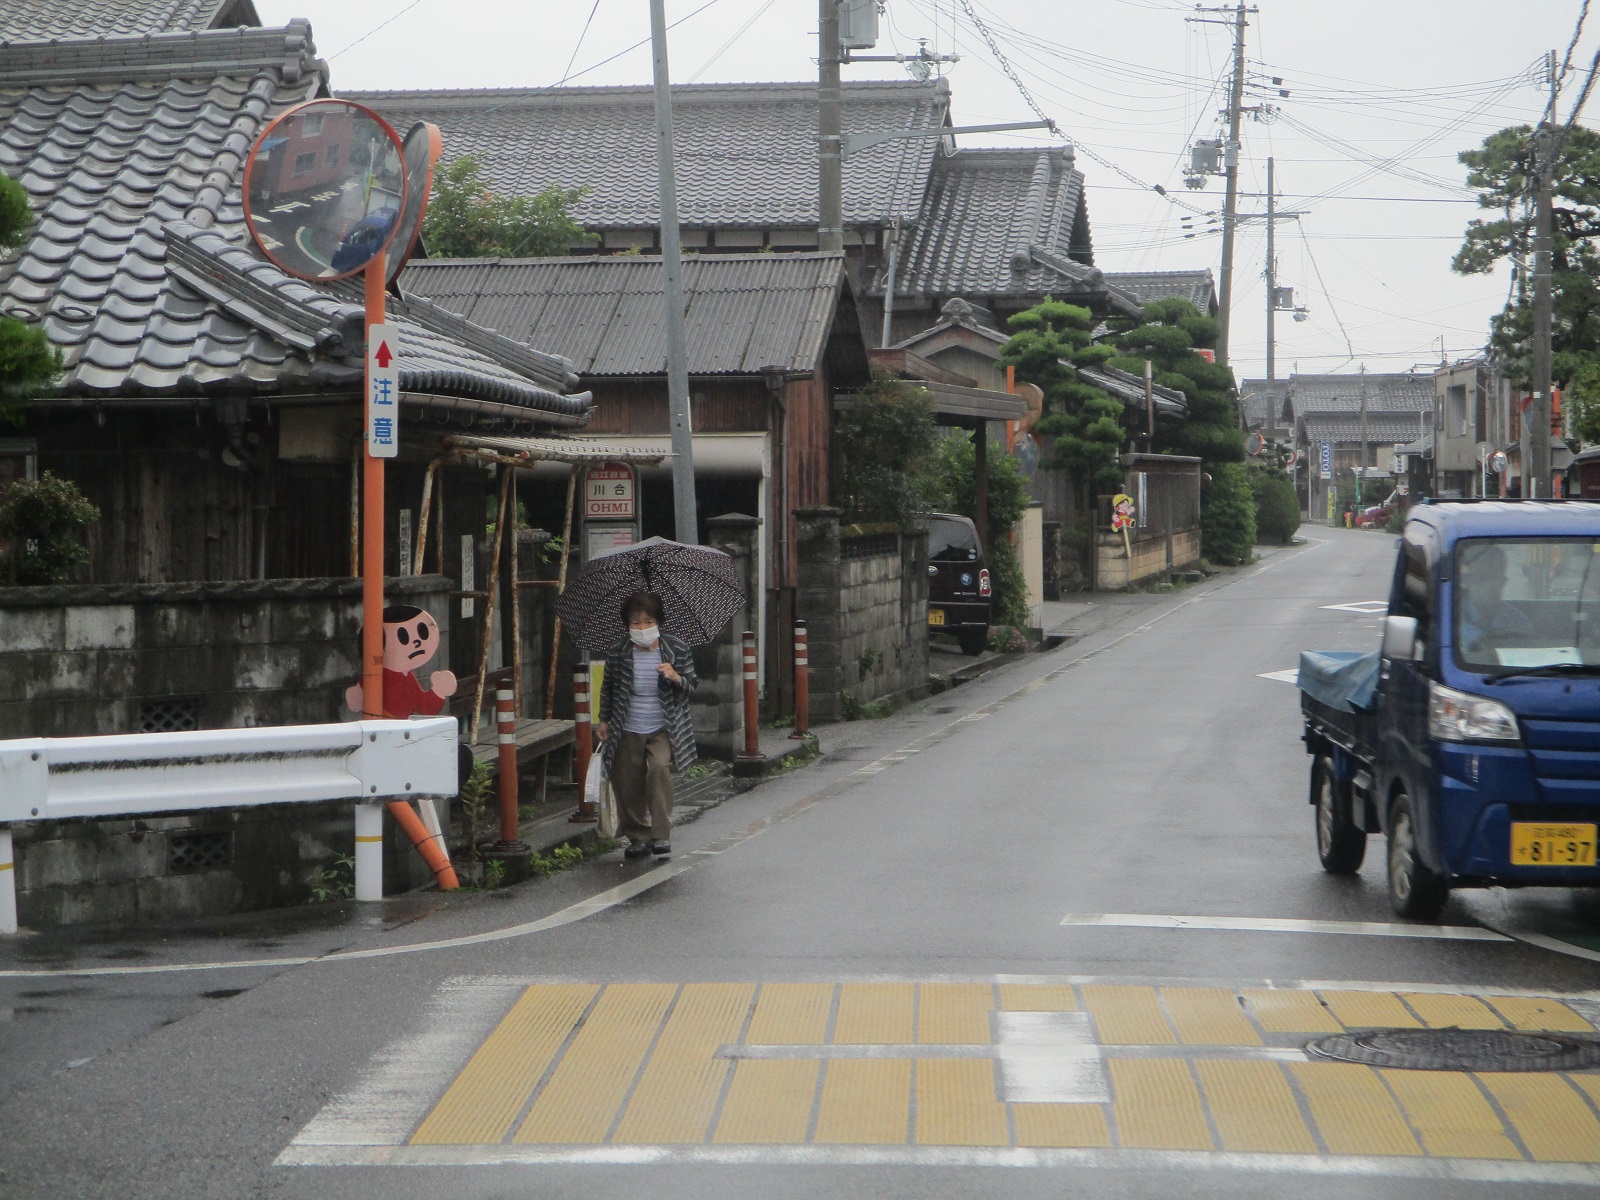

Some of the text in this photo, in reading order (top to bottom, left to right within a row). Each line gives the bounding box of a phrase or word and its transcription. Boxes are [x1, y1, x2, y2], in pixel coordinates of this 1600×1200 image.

[373, 377, 393, 445] 注意
[1322, 443, 1330, 471] TOTO
[593, 483, 626, 496] 川合
[590, 502, 629, 513] OHMI
[1530, 841, 1591, 862] 81-97
